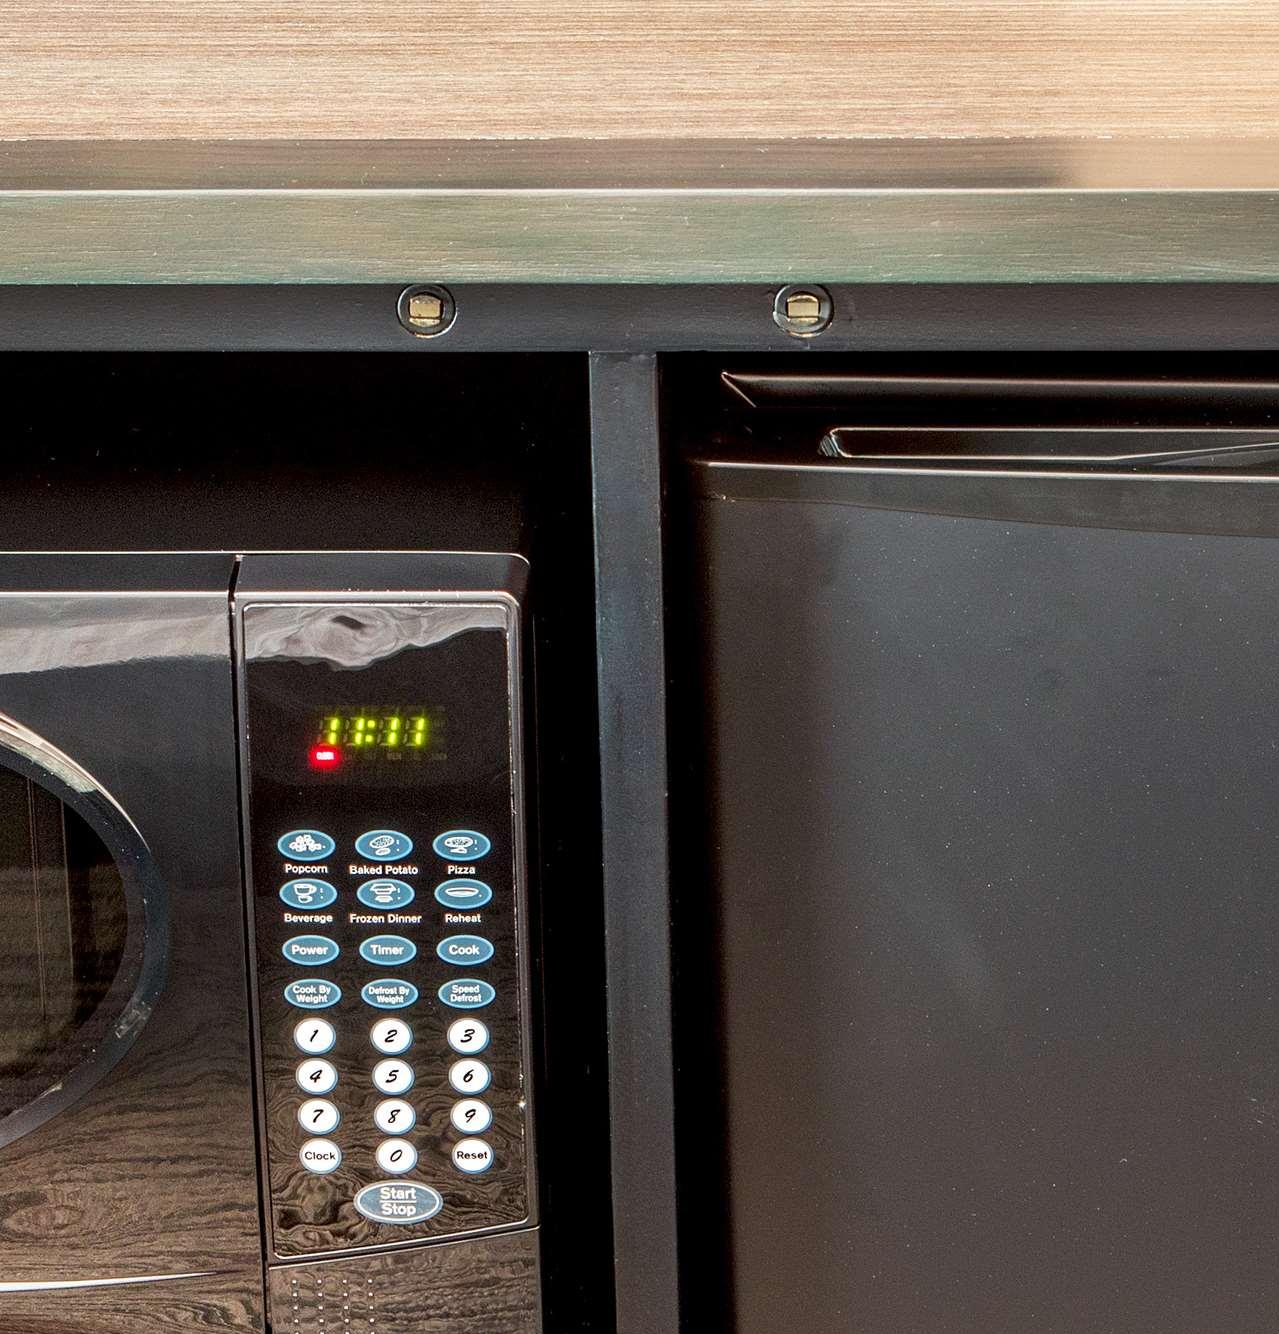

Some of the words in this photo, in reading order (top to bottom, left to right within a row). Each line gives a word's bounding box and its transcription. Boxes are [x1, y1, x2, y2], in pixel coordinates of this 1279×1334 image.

[323, 716, 425, 746] 11:11
[285, 864, 328, 874] Popcorn
[350, 865, 382, 875] Baked
[385, 865, 418, 875] Potato
[447, 865, 475, 875] Pizza
[284, 913, 333, 924] Beverage
[350, 914, 385, 923] Frozen
[388, 914, 422, 923] Dinner
[445, 913, 481, 923] Reheat
[291, 945, 328, 955] Power
[370, 945, 404, 955] Timer
[449, 945, 480, 955] Cook
[293, 986, 317, 994] Cook
[319, 986, 331, 995] By
[368, 986, 396, 995] Defrost
[397, 987, 410, 996] By
[452, 985, 480, 995] Speed
[296, 995, 328, 1004] Weight
[376, 995, 404, 1004] Weight
[450, 994, 482, 1002] Defrost
[309, 1029, 319, 1042] 1
[384, 1029, 398, 1042] 2
[460, 1028, 475, 1043] 3
[309, 1069, 323, 1083] 4
[386, 1069, 399, 1083] 5
[463, 1069, 474, 1082] 6
[313, 1109, 324, 1123] 7
[388, 1109, 400, 1123] 8
[464, 1109, 477, 1123] 9
[304, 1151, 336, 1160] Clock
[390, 1150, 403, 1162] 0
[456, 1151, 488, 1160] Reset
[380, 1187, 416, 1200] Start
[381, 1203, 416, 1217] Stop
